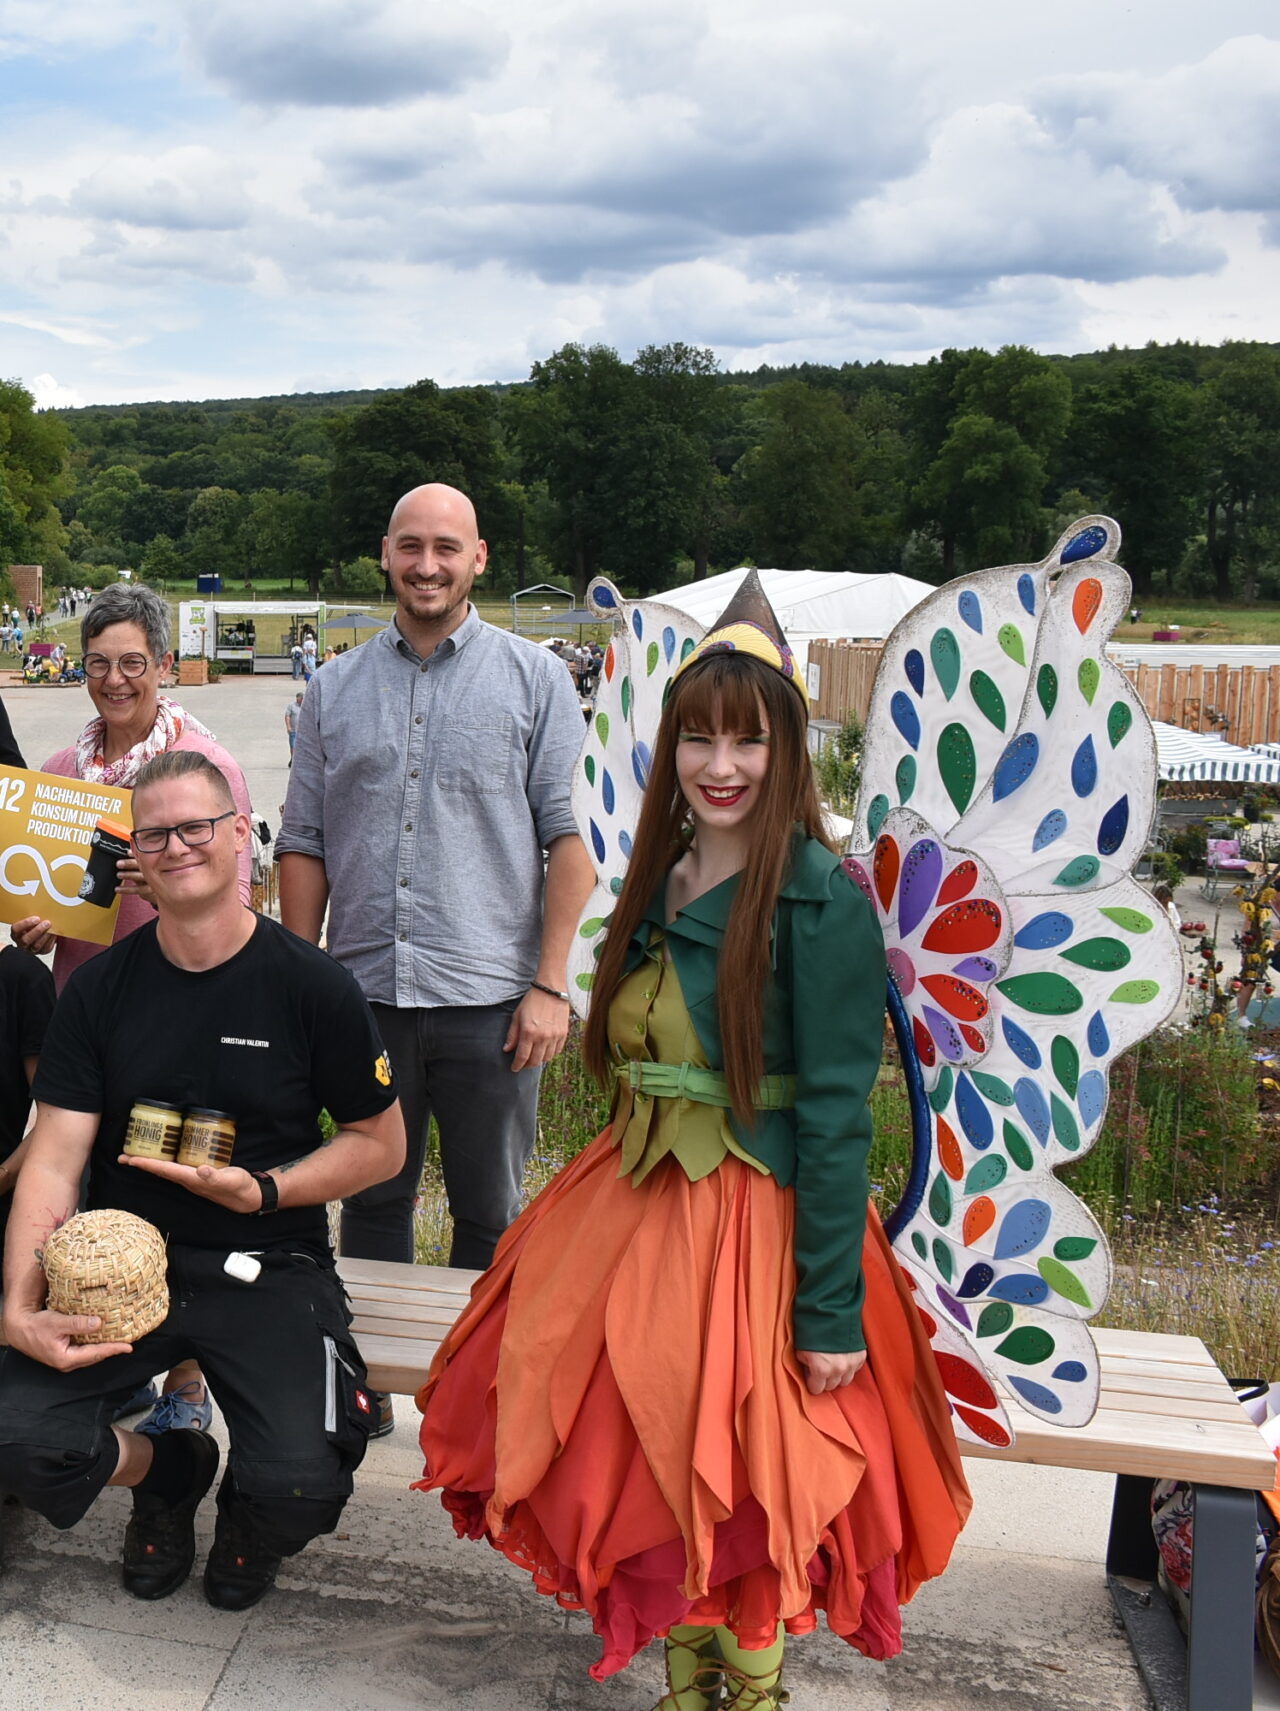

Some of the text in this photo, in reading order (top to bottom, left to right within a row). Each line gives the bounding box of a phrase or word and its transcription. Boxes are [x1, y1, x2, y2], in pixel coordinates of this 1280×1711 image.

[35, 783, 122, 814] NACHHALTIGE/R
[31, 801, 78, 824] KONSUM
[221, 1037, 246, 1046] CHRISTIAN
[134, 1125, 161, 1141] HONIG
[182, 1134, 208, 1148] HONIG
